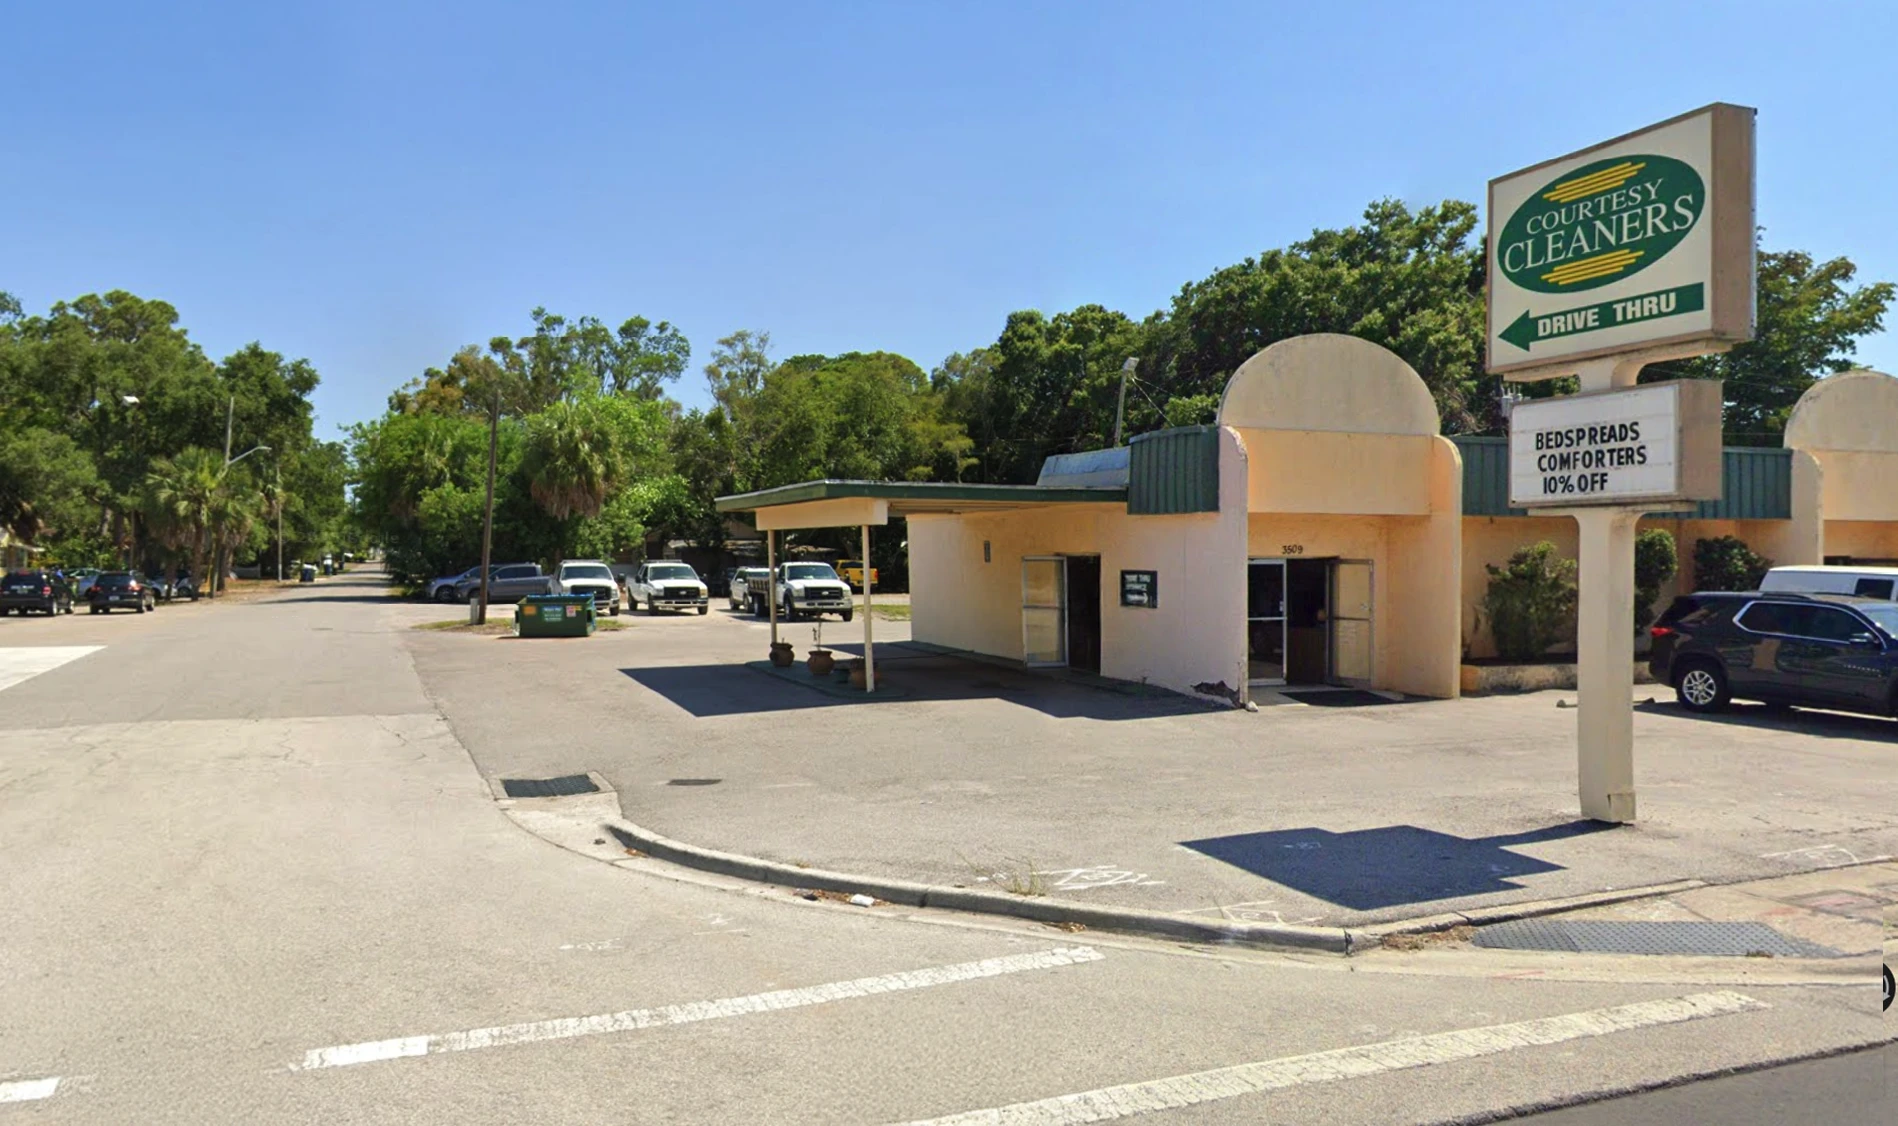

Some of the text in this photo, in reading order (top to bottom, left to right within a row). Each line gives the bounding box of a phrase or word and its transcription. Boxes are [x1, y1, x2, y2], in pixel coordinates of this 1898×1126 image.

[1526, 178, 1664, 235] COURTESY
[1504, 194, 1694, 273] CLEANERS
[1537, 292, 1677, 337] DRIVE THRU
[1535, 421, 1640, 451] BEDSPREADS
[1537, 445, 1647, 472] COMFORTERS
[1543, 472, 1608, 494] 10% OFF
[1282, 544, 1304, 555] 3509
